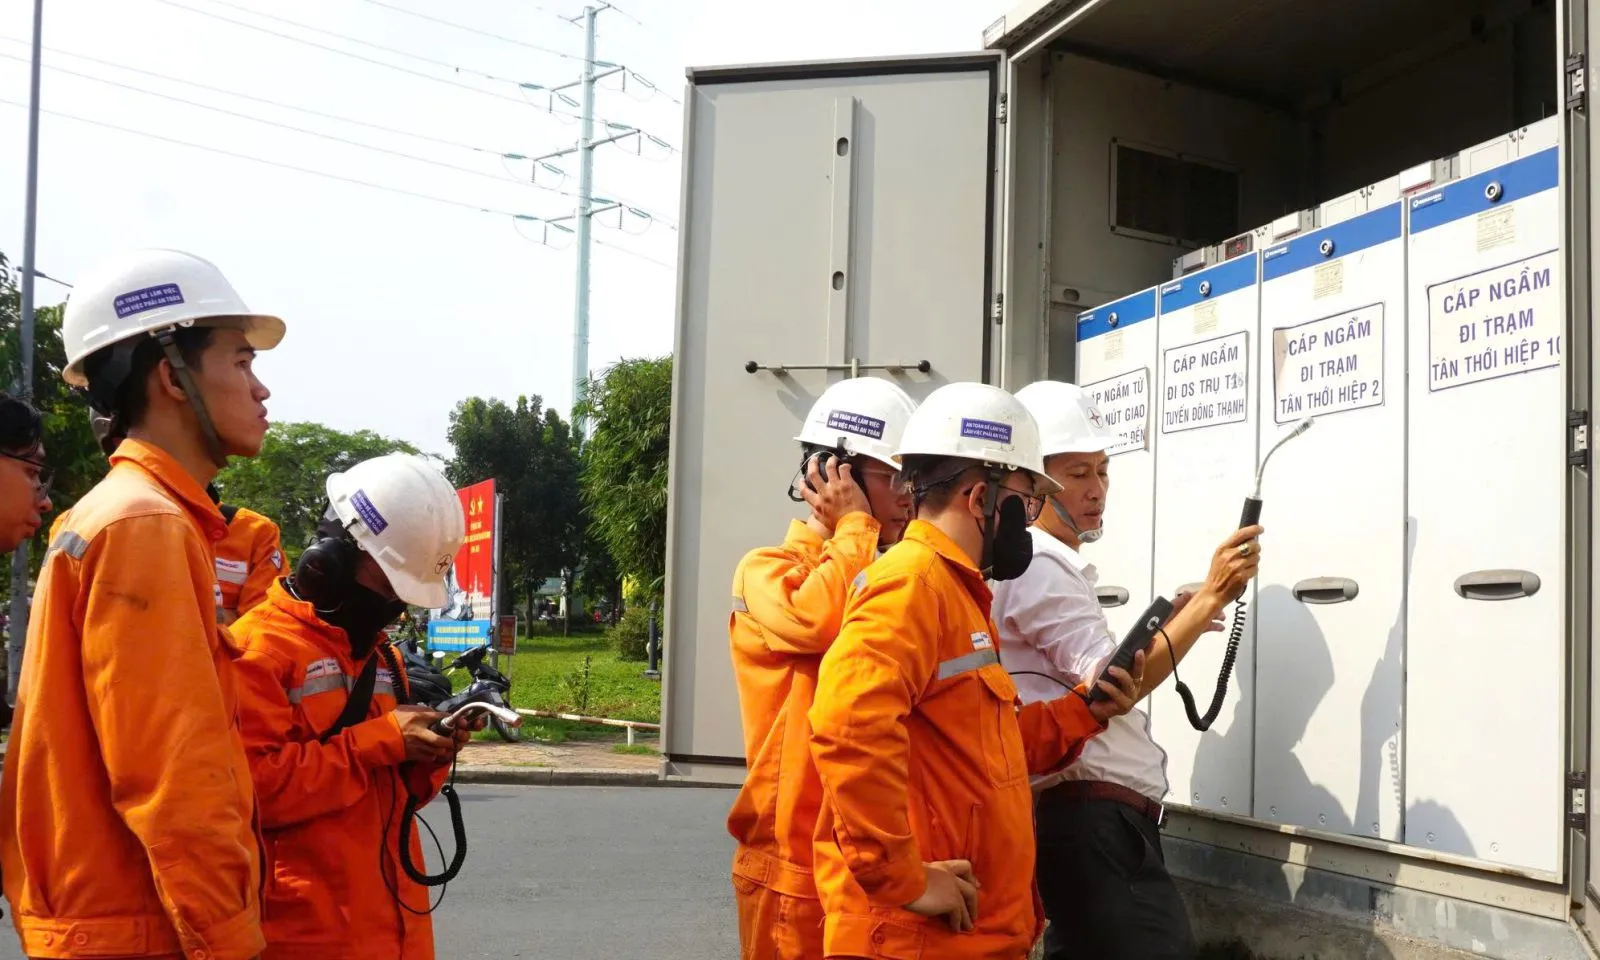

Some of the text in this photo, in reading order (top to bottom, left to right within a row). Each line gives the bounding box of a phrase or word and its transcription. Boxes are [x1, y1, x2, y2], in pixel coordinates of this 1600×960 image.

[1443, 266, 1551, 314] CÁP NGẦM
[1289, 316, 1371, 356] CÁP NGẦM
[1460, 308, 1534, 343] ĐI TRẠM
[1174, 354, 1196, 373] CÁP
[1301, 354, 1357, 382] ĐI TRẠM
[1432, 357, 1458, 381] TÂN
[1464, 347, 1497, 374] THỚI
[1504, 339, 1540, 366] HIỆP
[1167, 385, 1177, 400] ĐI
[1181, 382, 1195, 398] DS
[1200, 377, 1220, 394] TRỤ
[1280, 380, 1379, 414] TÂN THỚI HIỆP 2
[1105, 404, 1145, 426] NÚT GIAO
[1165, 399, 1244, 426] TUYẾN ĐÔNG THẠNH
